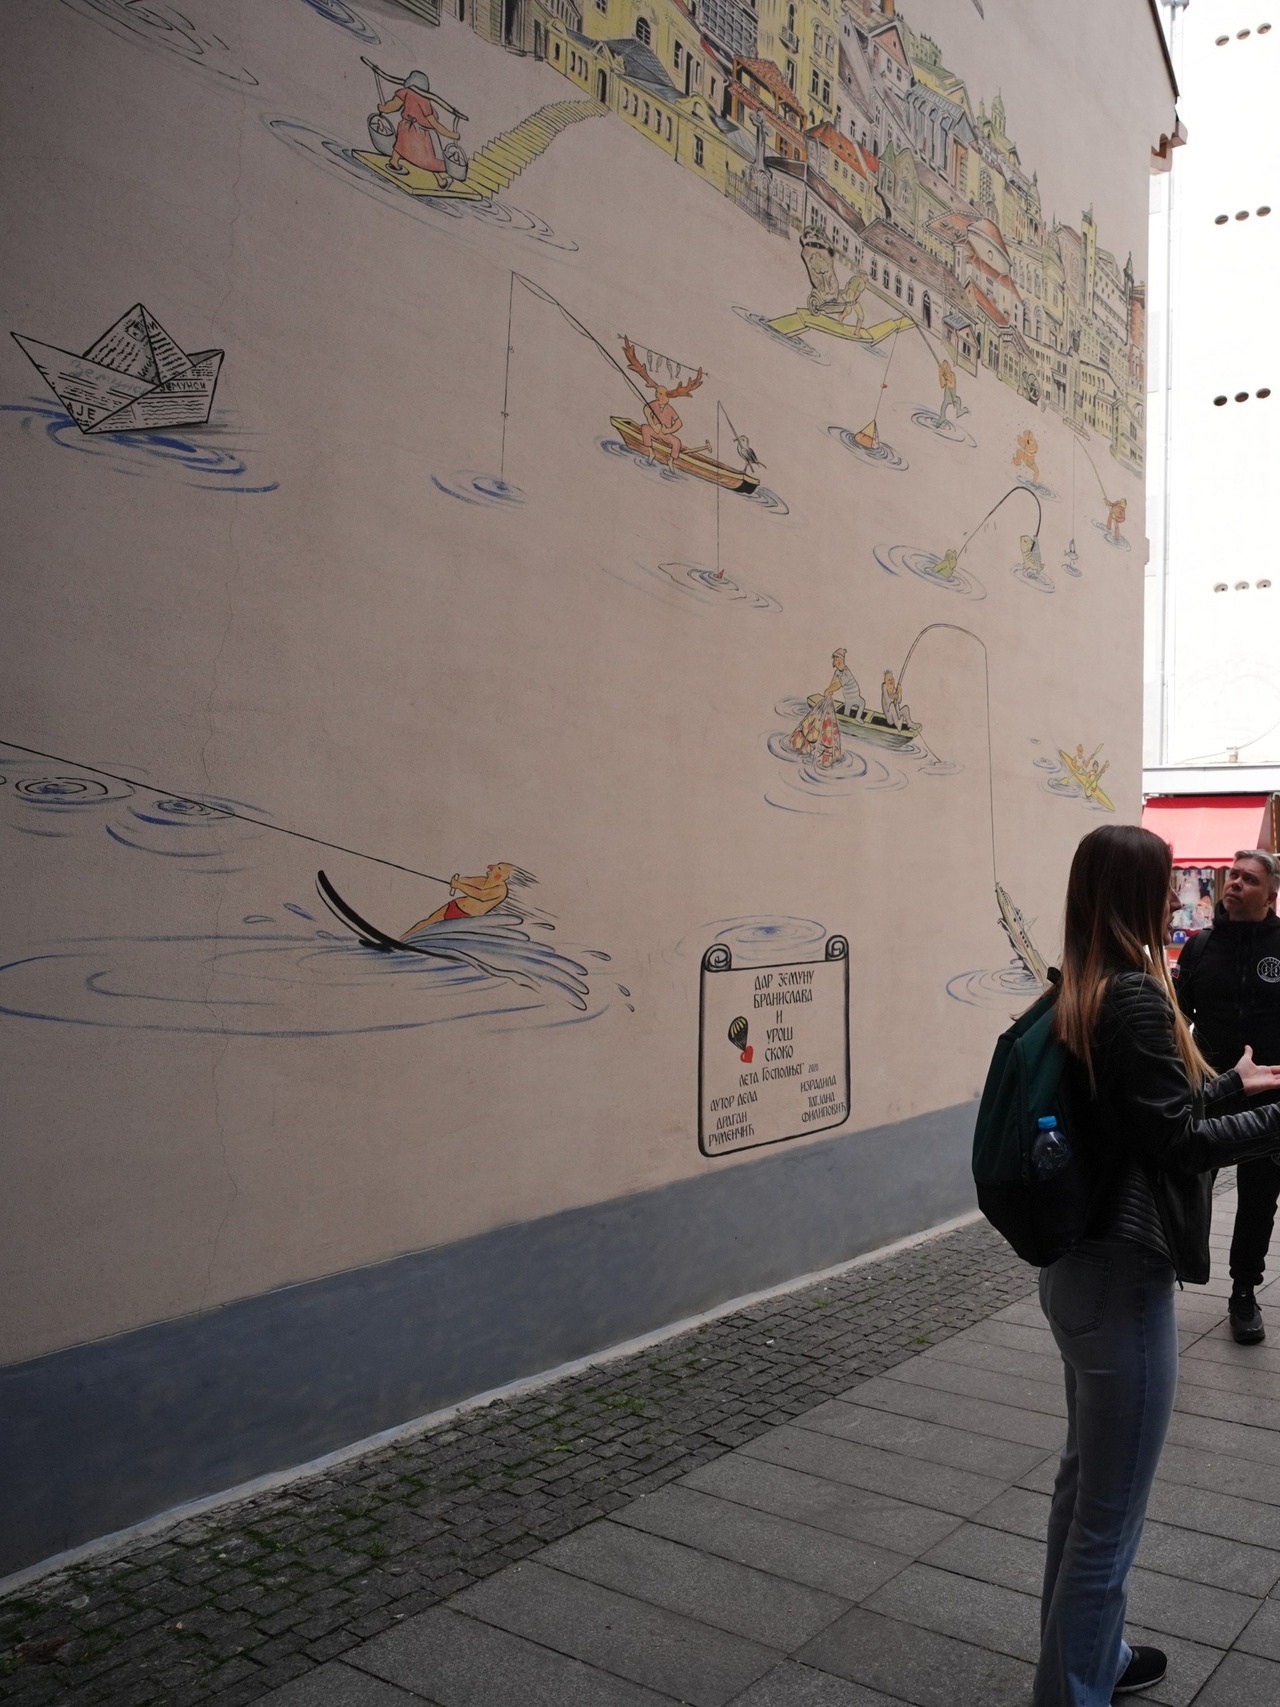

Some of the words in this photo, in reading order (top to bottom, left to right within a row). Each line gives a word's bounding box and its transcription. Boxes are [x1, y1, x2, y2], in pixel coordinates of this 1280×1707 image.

[754, 974, 773, 991] ДАР
[778, 970, 815, 988] ЗЕМУНУ
[753, 988, 813, 1009] БРАНИСЛАВА
[776, 1009, 783, 1024] И
[766, 1026, 793, 1045] УРОШ
[764, 1045, 794, 1062] СКОКО
[710, 1095, 735, 1112] АУТОР
[737, 1090, 758, 1107] ДЕЛА
[716, 1111, 748, 1131] ДРАГАН
[801, 1101, 847, 1123] ФИЛИПОВИЋ
